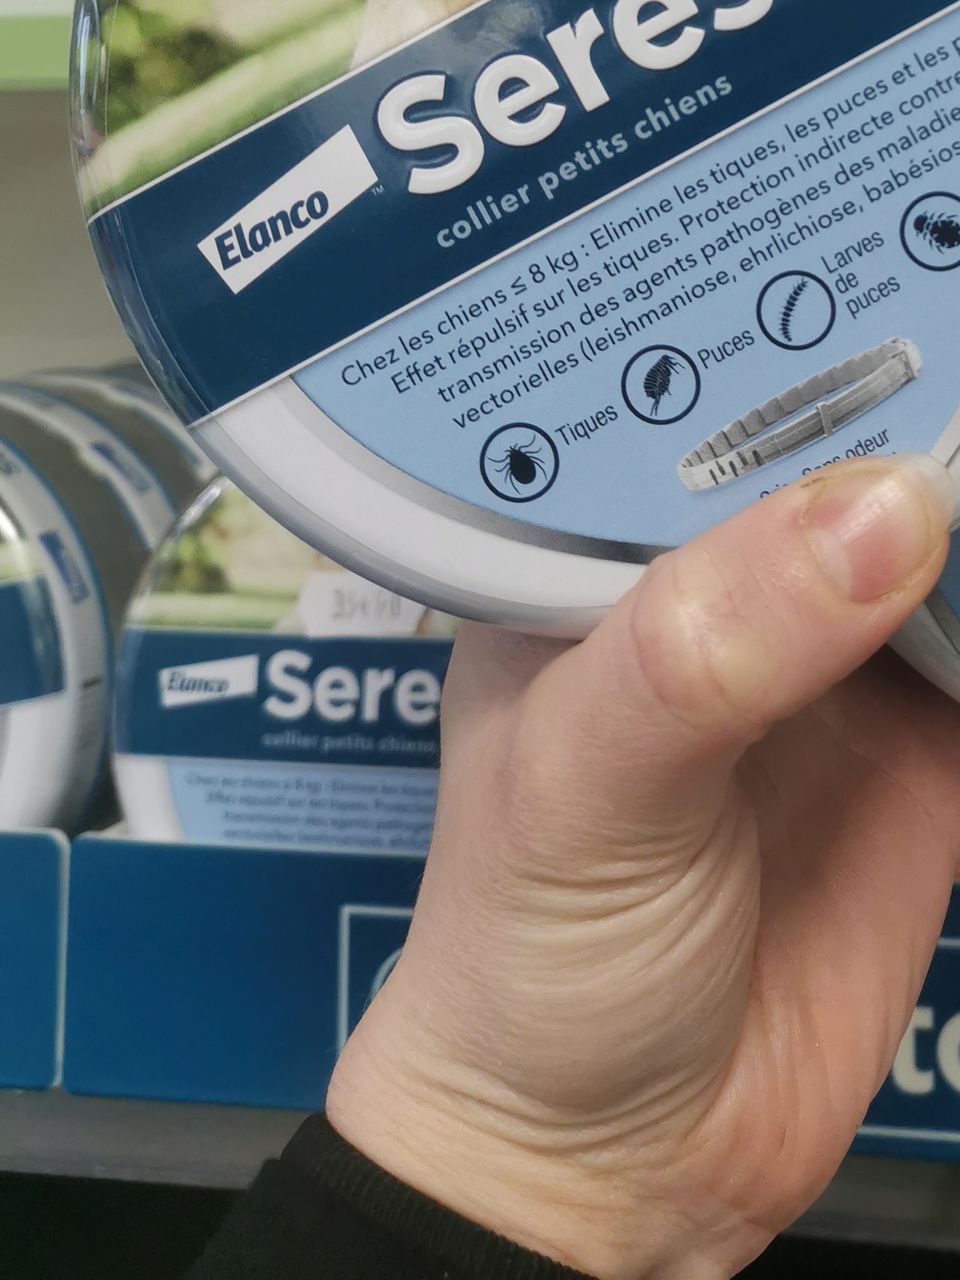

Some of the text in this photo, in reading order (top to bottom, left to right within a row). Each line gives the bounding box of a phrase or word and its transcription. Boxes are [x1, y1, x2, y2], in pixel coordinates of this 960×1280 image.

[436, 72, 735, 250] collier petits chiens
[216, 189, 331, 271] Elanco
[340, 349, 401, 386] Chez
[398, 326, 435, 357] les
[436, 288, 508, 337] chiens
[527, 261, 547, 285] 8
[547, 248, 580, 277] kg
[589, 196, 675, 251] Elimine
[673, 175, 710, 207] les
[708, 137, 788, 186] tiques,
[785, 115, 822, 145] les
[821, 78, 890, 130] puces
[890, 62, 918, 88] et
[912, 44, 951, 72] les
[389, 356, 448, 396] Effet
[447, 303, 531, 366] répulsif
[532, 284, 567, 319] sur
[566, 269, 604, 298] les
[602, 229, 681, 279] tiques.
[678, 164, 797, 237] Protection
[796, 106, 896, 173] indirecte
[436, 318, 578, 404] transmission
[578, 295, 621, 328] des
[622, 251, 699, 305] agents
[699, 178, 833, 264] pathogènes
[833, 153, 885, 188] des
[820, 228, 886, 276] Larves
[832, 269, 861, 296] de
[450, 348, 580, 431] vectorielles
[578, 264, 738, 366] (leishmaniose,
[738, 196, 865, 273] ehrlichiose,
[844, 274, 902, 321] puces
[697, 329, 756, 370] Puces
[554, 402, 620, 448] Tiques
[845, 428, 891, 459] odeur
